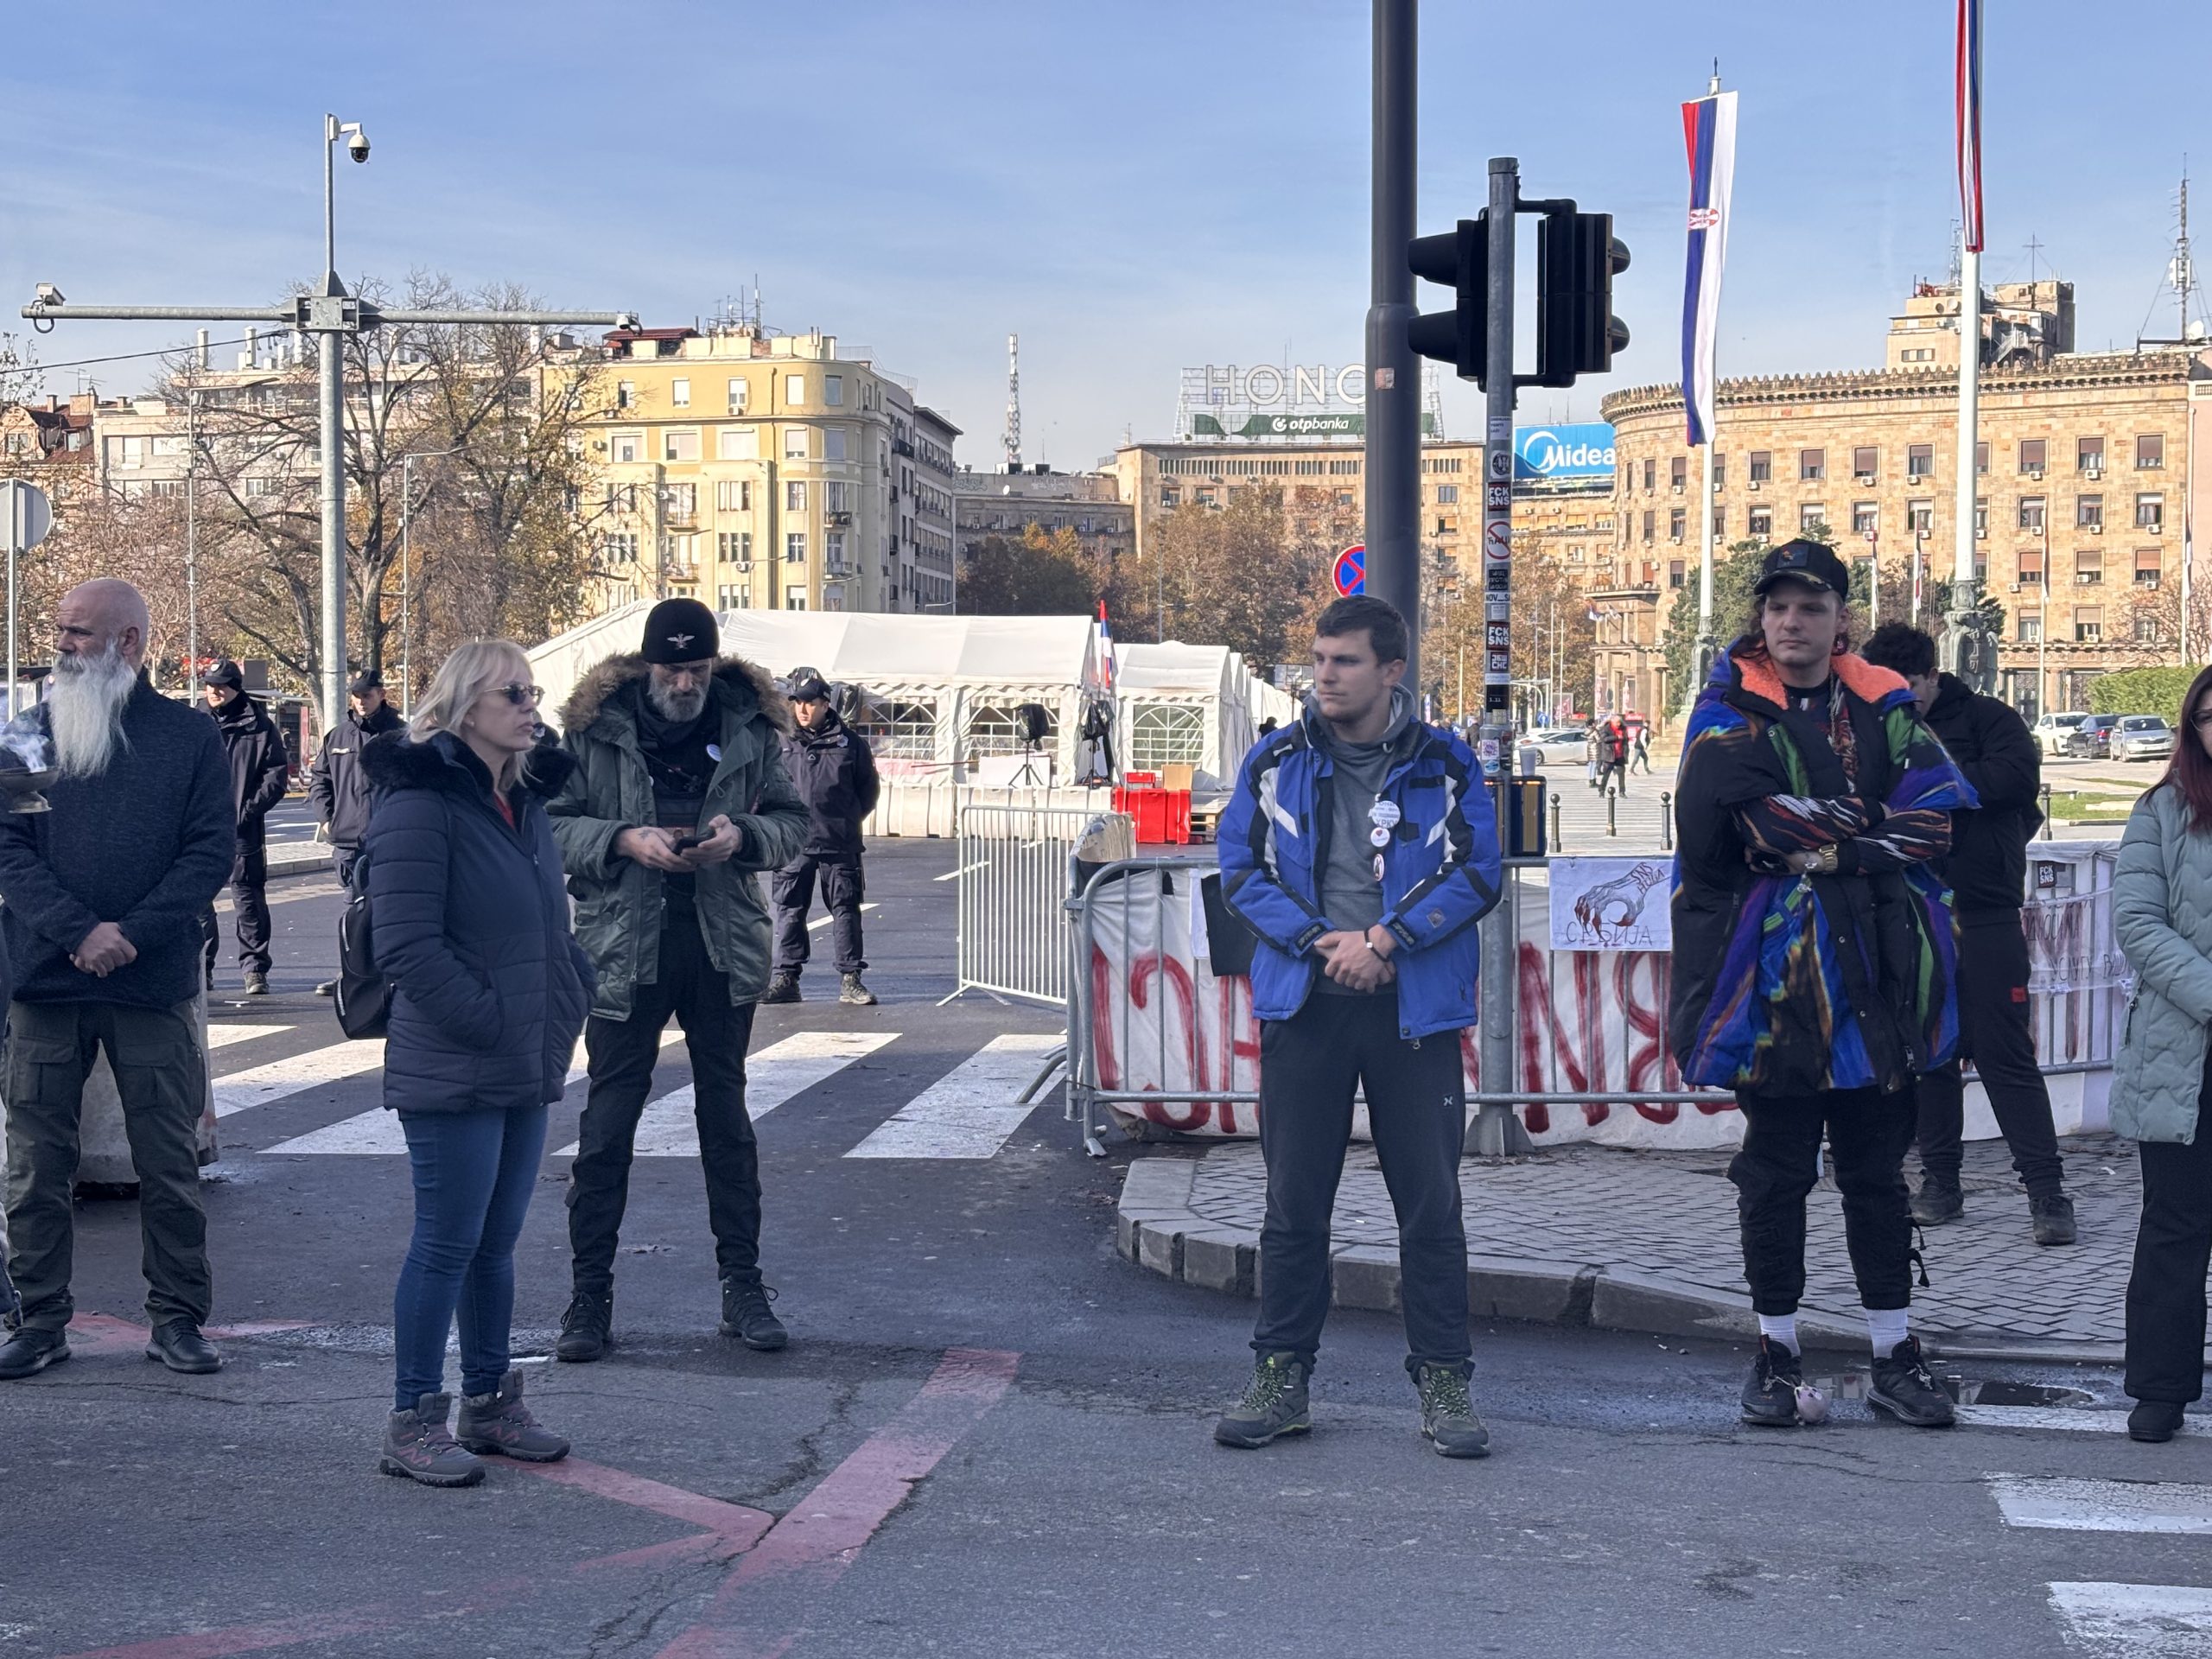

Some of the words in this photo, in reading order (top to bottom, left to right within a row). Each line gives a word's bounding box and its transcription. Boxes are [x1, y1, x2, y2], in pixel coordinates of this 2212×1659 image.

[1535, 442, 1616, 473] Midea
[1488, 486, 1510, 497] FCK
[1488, 497, 1510, 506] SNS
[1488, 626, 1510, 636] FCK
[1488, 636, 1510, 645] SNS
[2039, 865, 2054, 875] FCK
[2039, 874, 2055, 884] SNS
[1566, 921, 1653, 946] СРБИЈА
